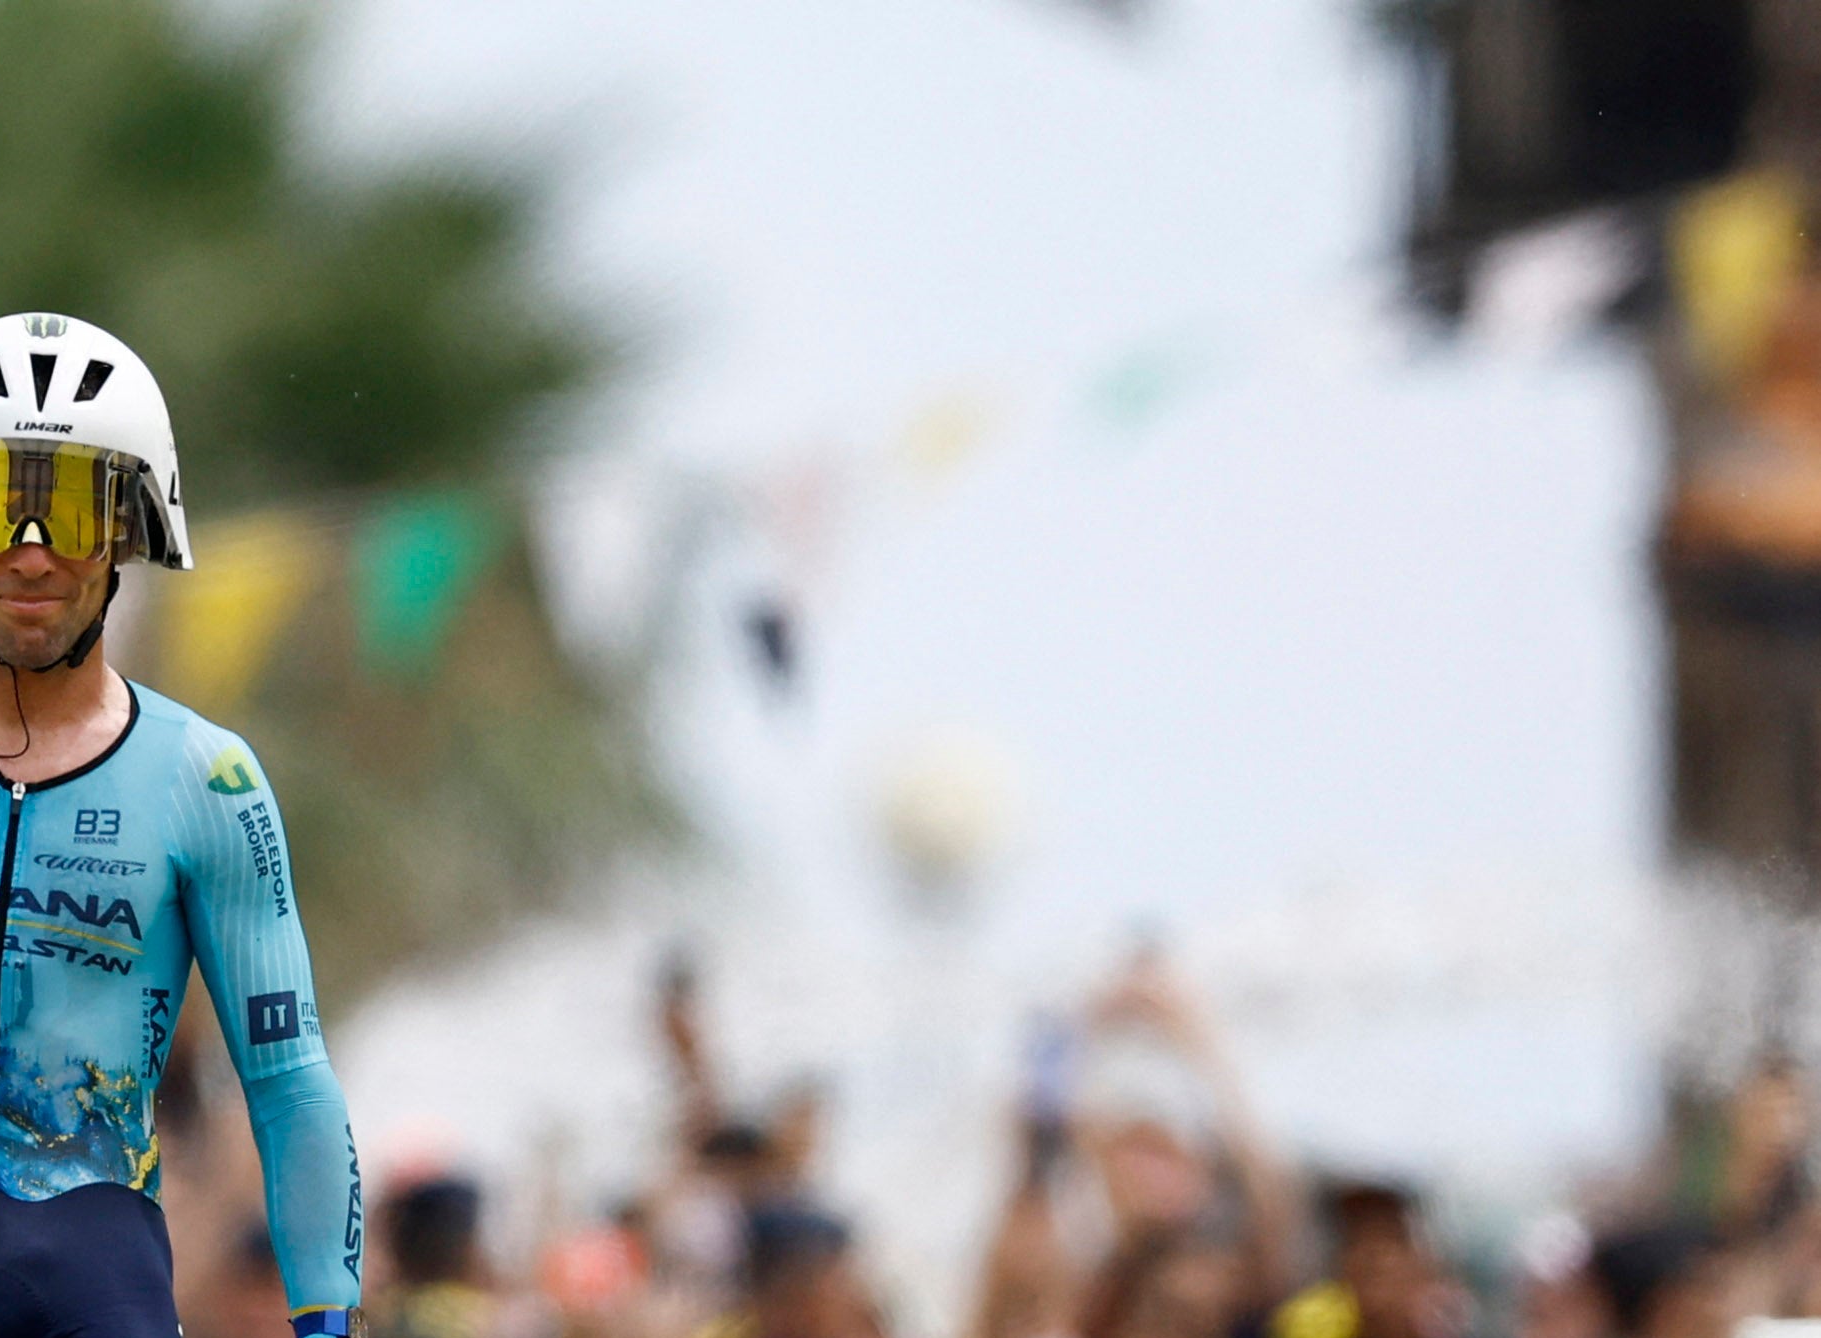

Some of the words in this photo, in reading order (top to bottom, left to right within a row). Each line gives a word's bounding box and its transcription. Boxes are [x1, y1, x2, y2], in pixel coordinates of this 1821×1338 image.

[75, 809, 121, 835] B3
[237, 809, 269, 879] BROKER
[34, 854, 147, 876] Wilier
[251, 801, 289, 918] FREEDOM
[148, 988, 170, 1079] KAZ
[263, 1004, 287, 1030] IT
